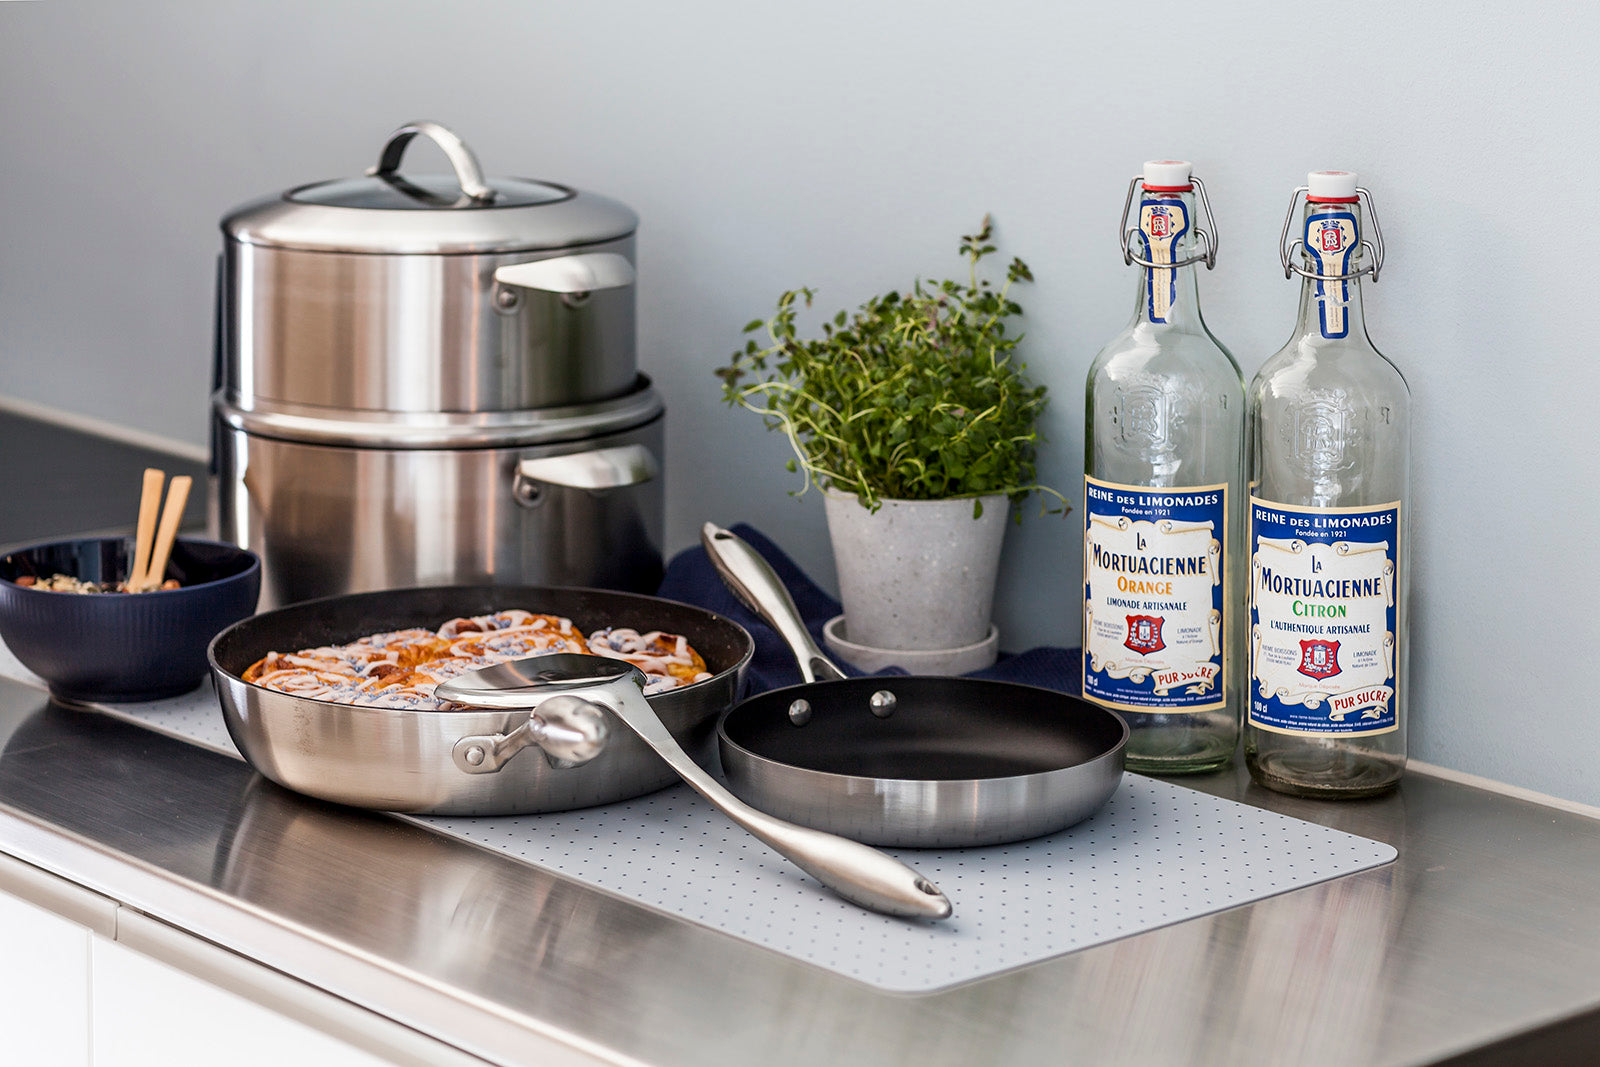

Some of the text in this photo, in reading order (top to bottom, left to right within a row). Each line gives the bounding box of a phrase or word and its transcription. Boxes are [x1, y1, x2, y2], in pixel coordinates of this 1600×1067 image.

[1088, 487, 1218, 507] REINE DES LIMONADES
[1121, 506, 1143, 515] Fondée
[1255, 509, 1392, 528] REINE DES LIMONADES
[1295, 528, 1318, 537] Fondée
[1093, 543, 1207, 576] MORTUACIENNE
[1117, 576, 1173, 595] ORANGE
[1261, 566, 1382, 598] MORTUACIENNE
[1106, 597, 1187, 611] LIMONADE ARTISANALE
[1292, 600, 1346, 618] CITRON
[1270, 620, 1370, 635] L'AUTHENTIQUE ARTISANALE
[1158, 672, 1179, 686] PUR
[1254, 700, 1268, 713] 100 cl
[1334, 690, 1388, 710] PUR SUCRE
